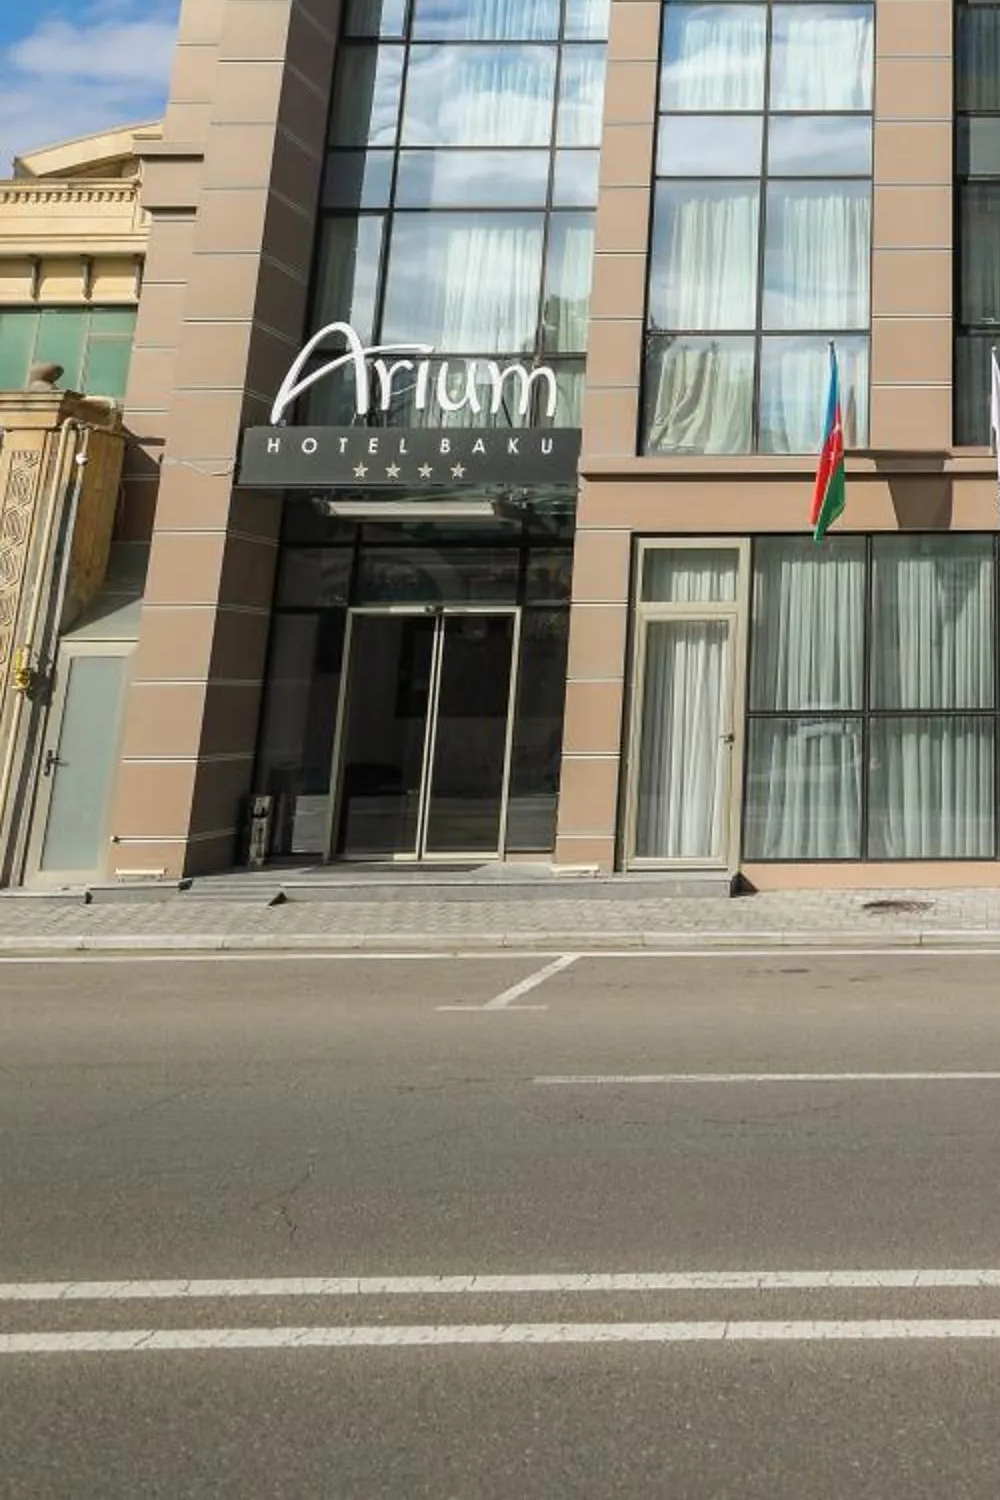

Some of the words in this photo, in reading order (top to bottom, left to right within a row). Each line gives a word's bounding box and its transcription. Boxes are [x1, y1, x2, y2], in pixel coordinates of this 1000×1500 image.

[270, 321, 557, 425] Arium
[266, 437, 409, 454] HOTEL
[439, 437, 554, 454] BAKU
